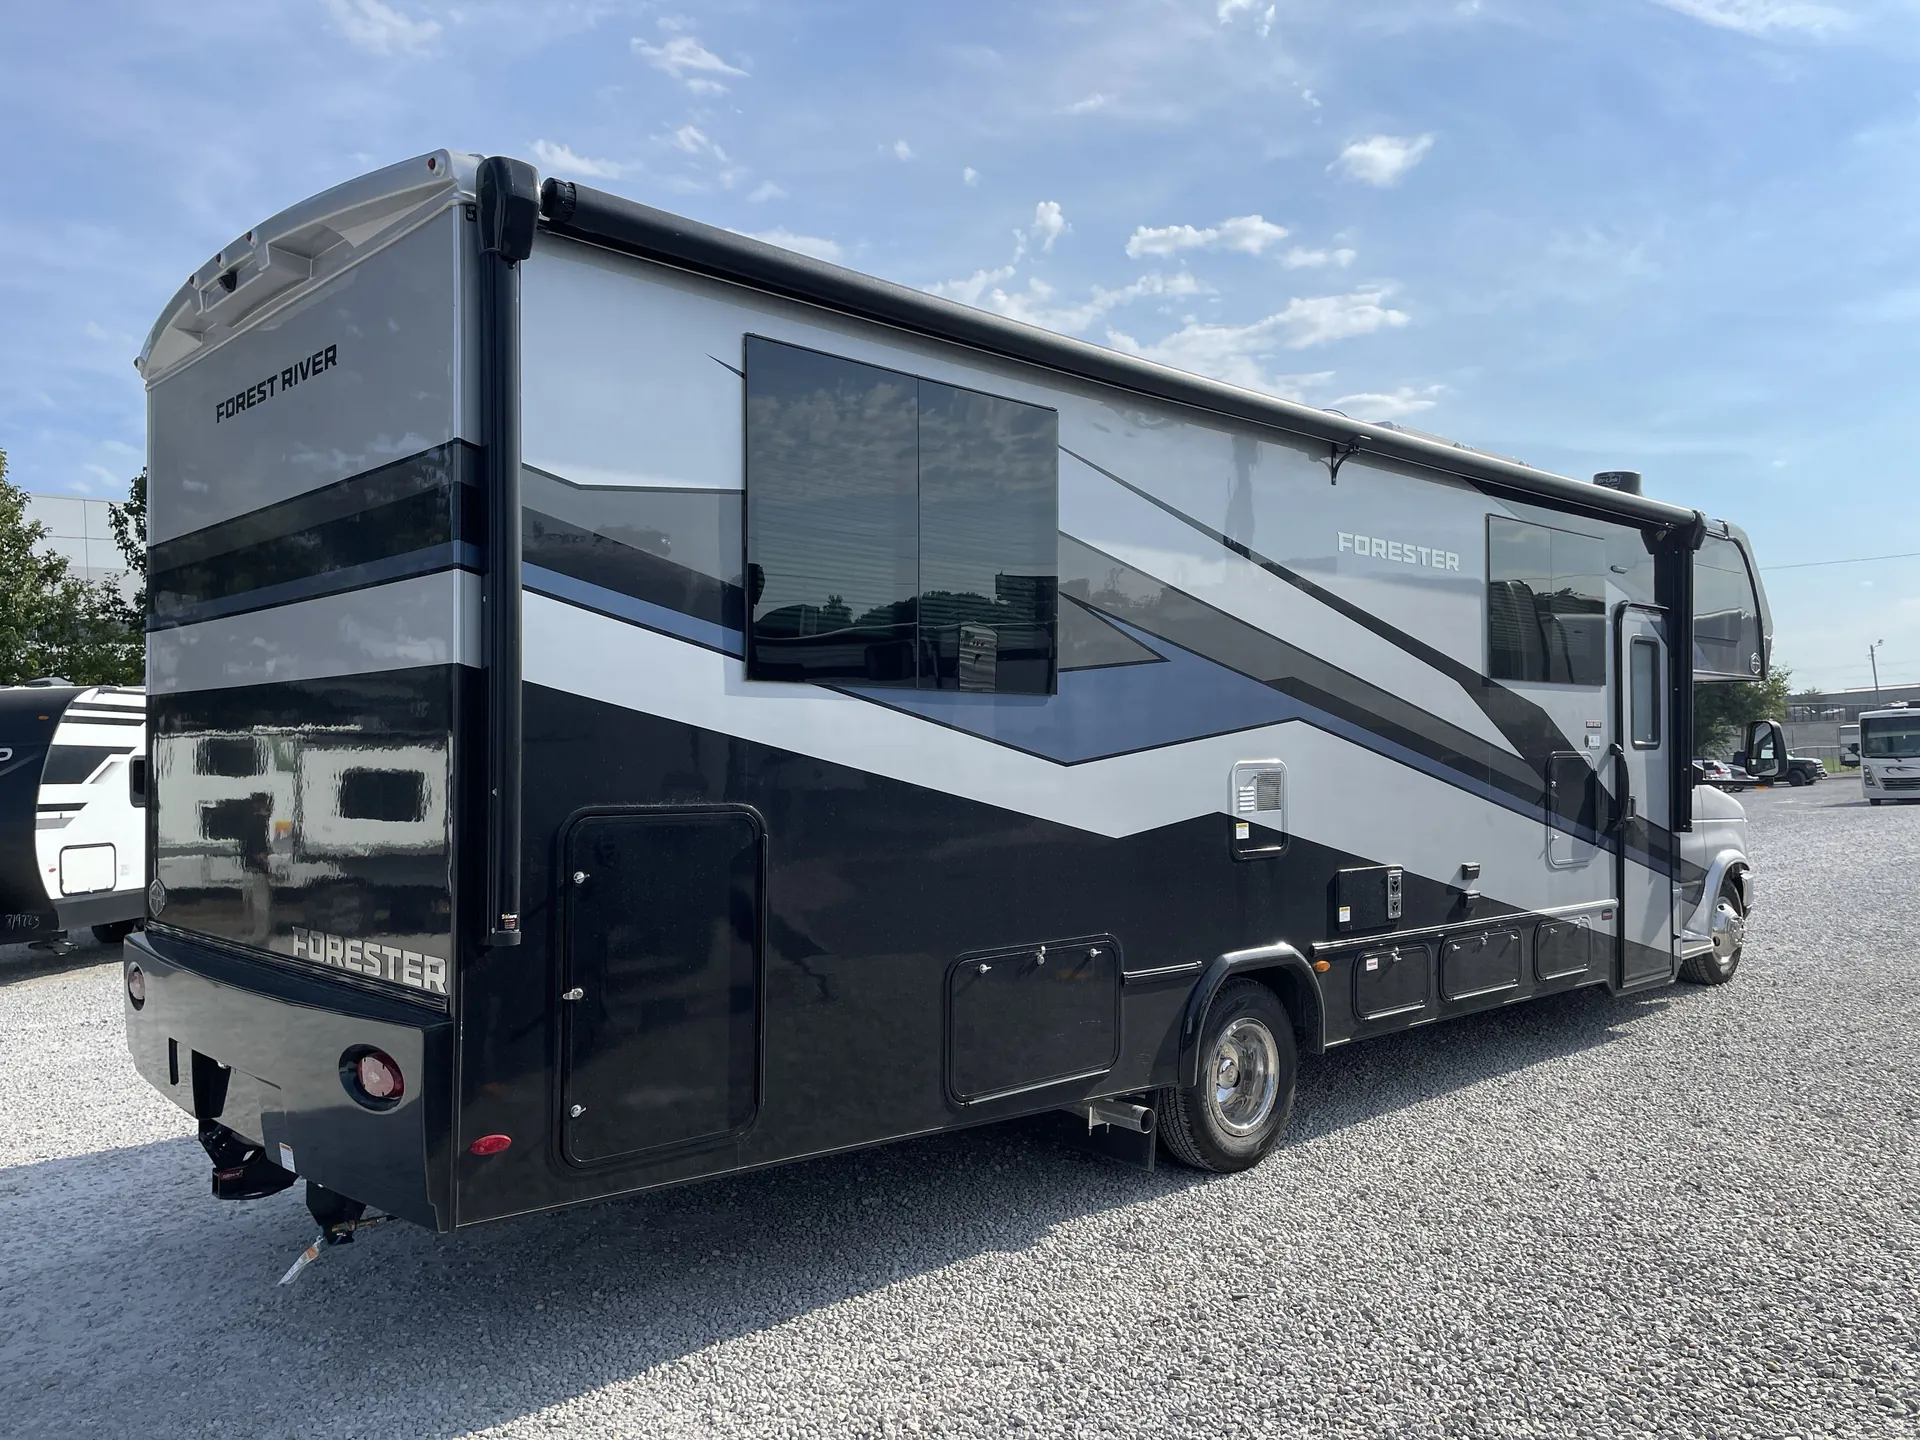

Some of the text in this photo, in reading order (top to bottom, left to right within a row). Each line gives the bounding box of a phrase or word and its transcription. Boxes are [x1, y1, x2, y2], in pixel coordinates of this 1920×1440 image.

[216, 344, 338, 424] FOREST RIVER
[1336, 531, 1460, 572] FORESTER
[292, 926, 447, 993] FORESTER
